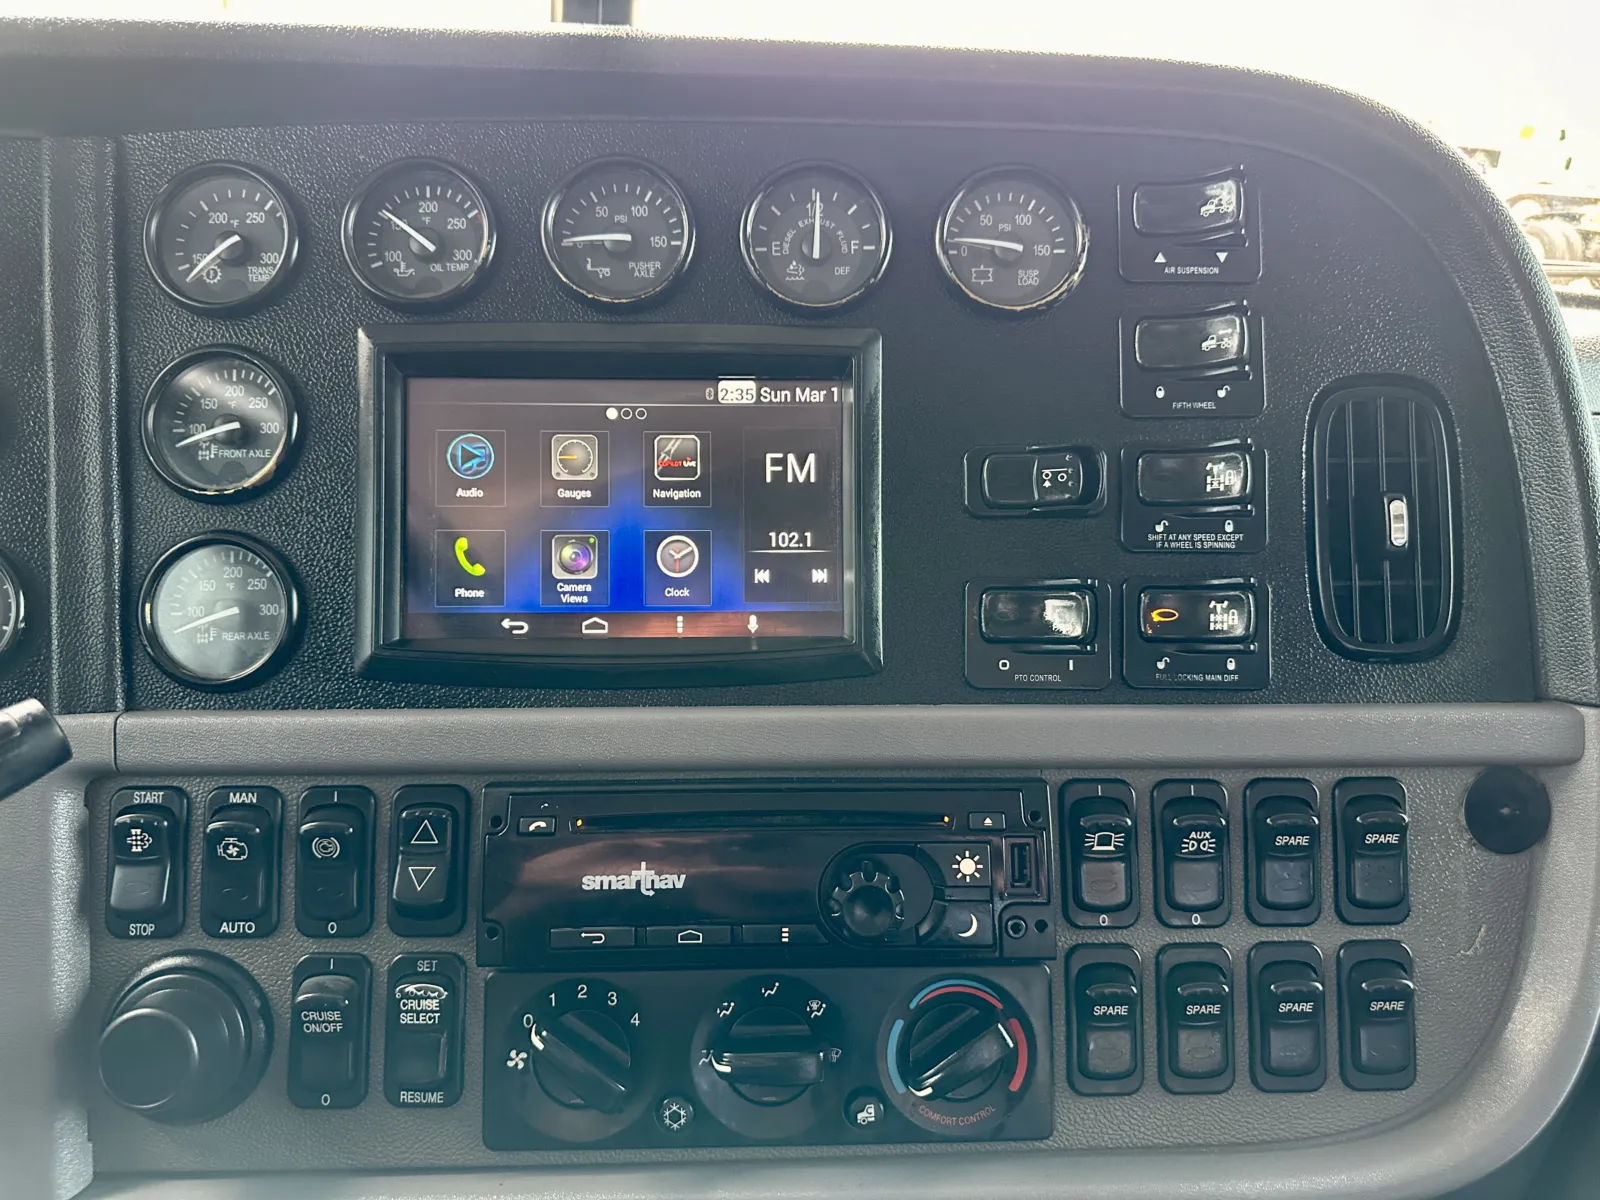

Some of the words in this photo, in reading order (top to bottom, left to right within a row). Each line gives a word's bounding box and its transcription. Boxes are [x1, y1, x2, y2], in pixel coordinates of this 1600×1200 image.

[419, 202, 438, 213] 200
[595, 206, 608, 217] 50
[631, 206, 648, 217] 100
[208, 212, 228, 223] 200
[246, 212, 265, 223] 250
[614, 215, 628, 223] PSI
[980, 215, 992, 225] 50
[1015, 215, 1031, 225] 100
[447, 218, 467, 229] 250
[650, 236, 667, 247] 150
[783, 229, 796, 254] DIESEL
[798, 218, 835, 229] EXHUST
[836, 231, 848, 253] FLUID
[772, 242, 781, 255] E
[851, 241, 859, 254] F
[961, 246, 967, 256] 0
[1033, 245, 1050, 255] 150
[260, 253, 279, 264] 300
[384, 251, 402, 262] 100
[452, 249, 472, 261] 300
[247, 266, 274, 274] TRANS
[430, 263, 444, 272] OIL
[447, 263, 469, 272] TEMP
[629, 262, 661, 270] PUSHER
[835, 267, 850, 275] DEF
[634, 270, 655, 278] AXLE
[1018, 270, 1039, 278] SUSP
[225, 385, 244, 396] 200
[720, 388, 754, 401] 2:35
[760, 387, 792, 402] Sun
[796, 388, 826, 402] Mar
[831, 387, 838, 402] 1
[201, 399, 218, 409] 150
[248, 398, 268, 408] 250
[260, 423, 279, 433] 300
[219, 450, 246, 458] FRONT
[248, 449, 272, 457] AXLE
[765, 453, 816, 483] FM
[456, 488, 484, 498] Audio
[557, 488, 592, 499] Gauges
[652, 488, 702, 500] Navigation
[768, 532, 812, 547] 102.1
[223, 567, 242, 578] 200
[199, 580, 216, 591] 150
[247, 579, 267, 590] 250
[556, 582, 592, 592] Camera
[454, 588, 485, 598] Phone
[664, 587, 690, 597] Clock
[560, 594, 588, 603] Views
[187, 606, 204, 617] 100
[260, 604, 279, 615] 300
[222, 632, 245, 640] REAR
[248, 631, 270, 640] AXLE
[1014, 674, 1028, 682] PTO
[1029, 674, 1061, 682] CONTROL
[133, 792, 164, 803] START
[229, 792, 257, 803] MAN
[1189, 831, 1211, 839] AUX
[1364, 834, 1400, 844] SPARE
[1275, 836, 1310, 846] SPARE
[129, 923, 155, 936] STOP
[219, 922, 255, 933] AUTO
[417, 960, 437, 971] SET
[577, 984, 588, 998] 2
[549, 993, 556, 1006] 1
[607, 992, 617, 1005] 3
[400, 999, 440, 1011] CRUISE
[1093, 1005, 1129, 1016] SPARE
[1186, 1005, 1221, 1015] SPARE
[1278, 1002, 1314, 1013] SPARE
[1369, 1001, 1405, 1011] SPARE
[301, 1011, 342, 1021] CRUISE
[400, 1012, 441, 1024] SELECT
[523, 1014, 534, 1028] 0
[630, 1013, 640, 1026] 4
[303, 1022, 343, 1033] ON/OFF
[400, 1091, 444, 1103] RESUME
[918, 1105, 957, 1125] COMFORT
[958, 1104, 996, 1125] CONTROL
